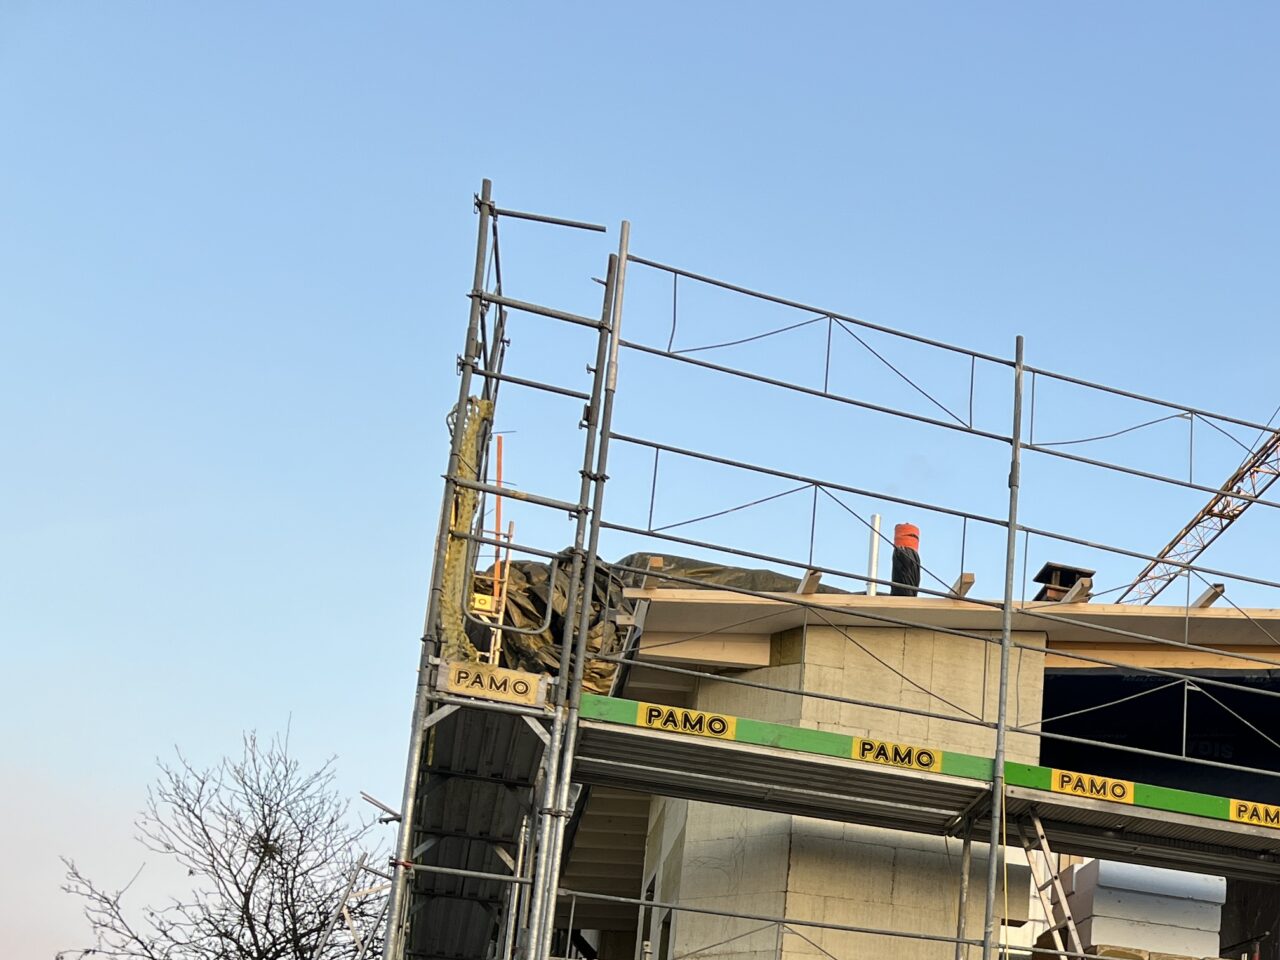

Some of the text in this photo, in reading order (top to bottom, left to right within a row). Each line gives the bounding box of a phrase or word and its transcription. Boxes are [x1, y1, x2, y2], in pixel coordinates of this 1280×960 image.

[455, 668, 530, 695] PAMO
[645, 705, 728, 737] PAMO
[858, 740, 935, 769] PAMO
[1059, 773, 1127, 799] PAMO
